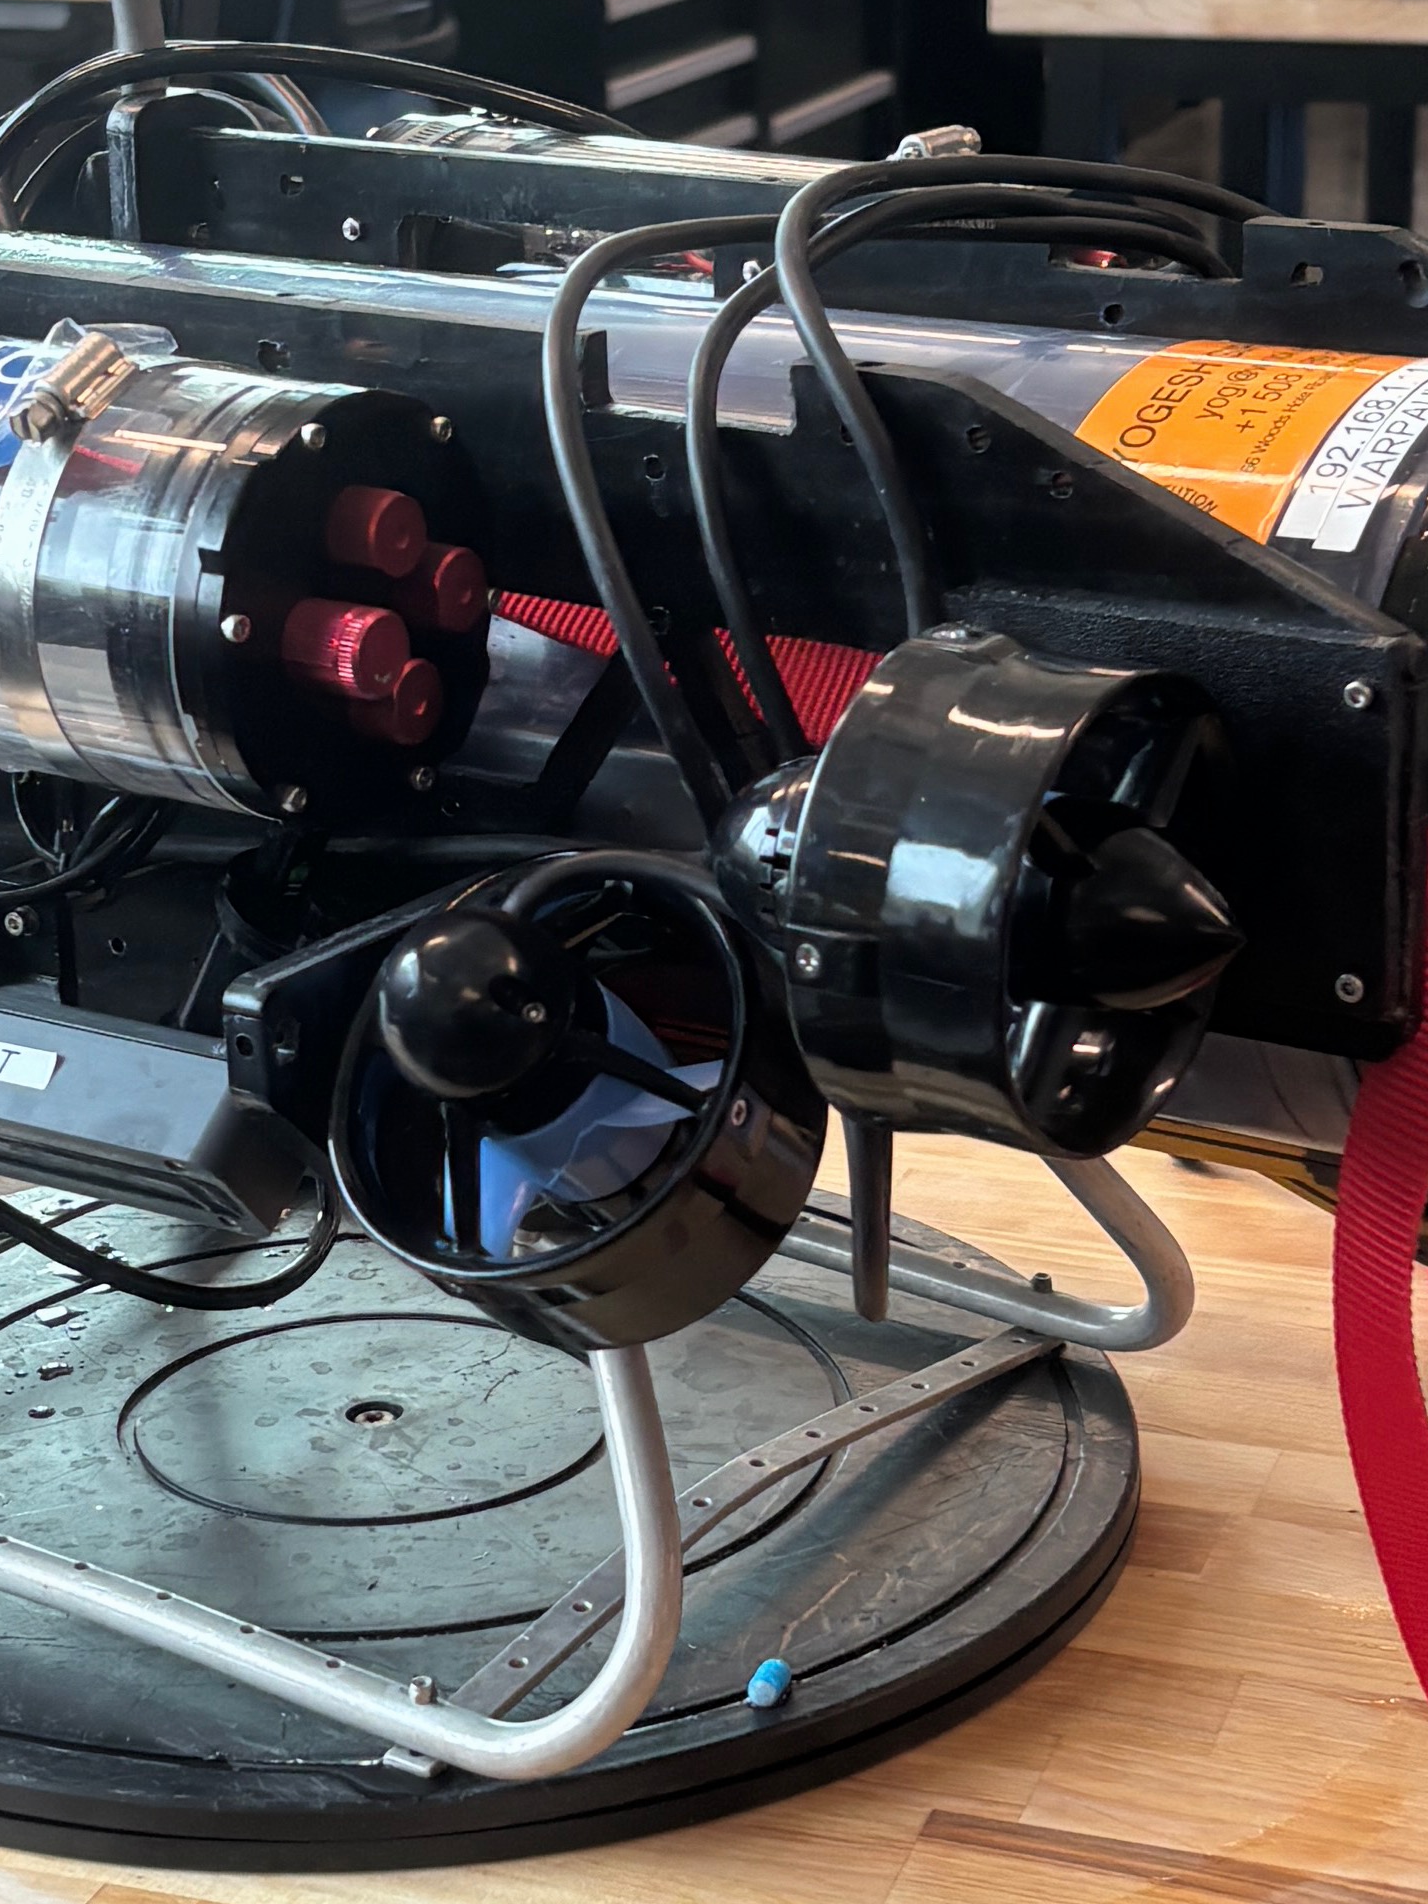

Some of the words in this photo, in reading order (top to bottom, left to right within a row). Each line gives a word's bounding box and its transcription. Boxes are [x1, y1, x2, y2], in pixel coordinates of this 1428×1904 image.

[1113, 362, 1223, 463] YOGESH
[1236, 407, 1268, 434] +1
[1253, 372, 1303, 403] 508
[1250, 414, 1292, 456] Woods
